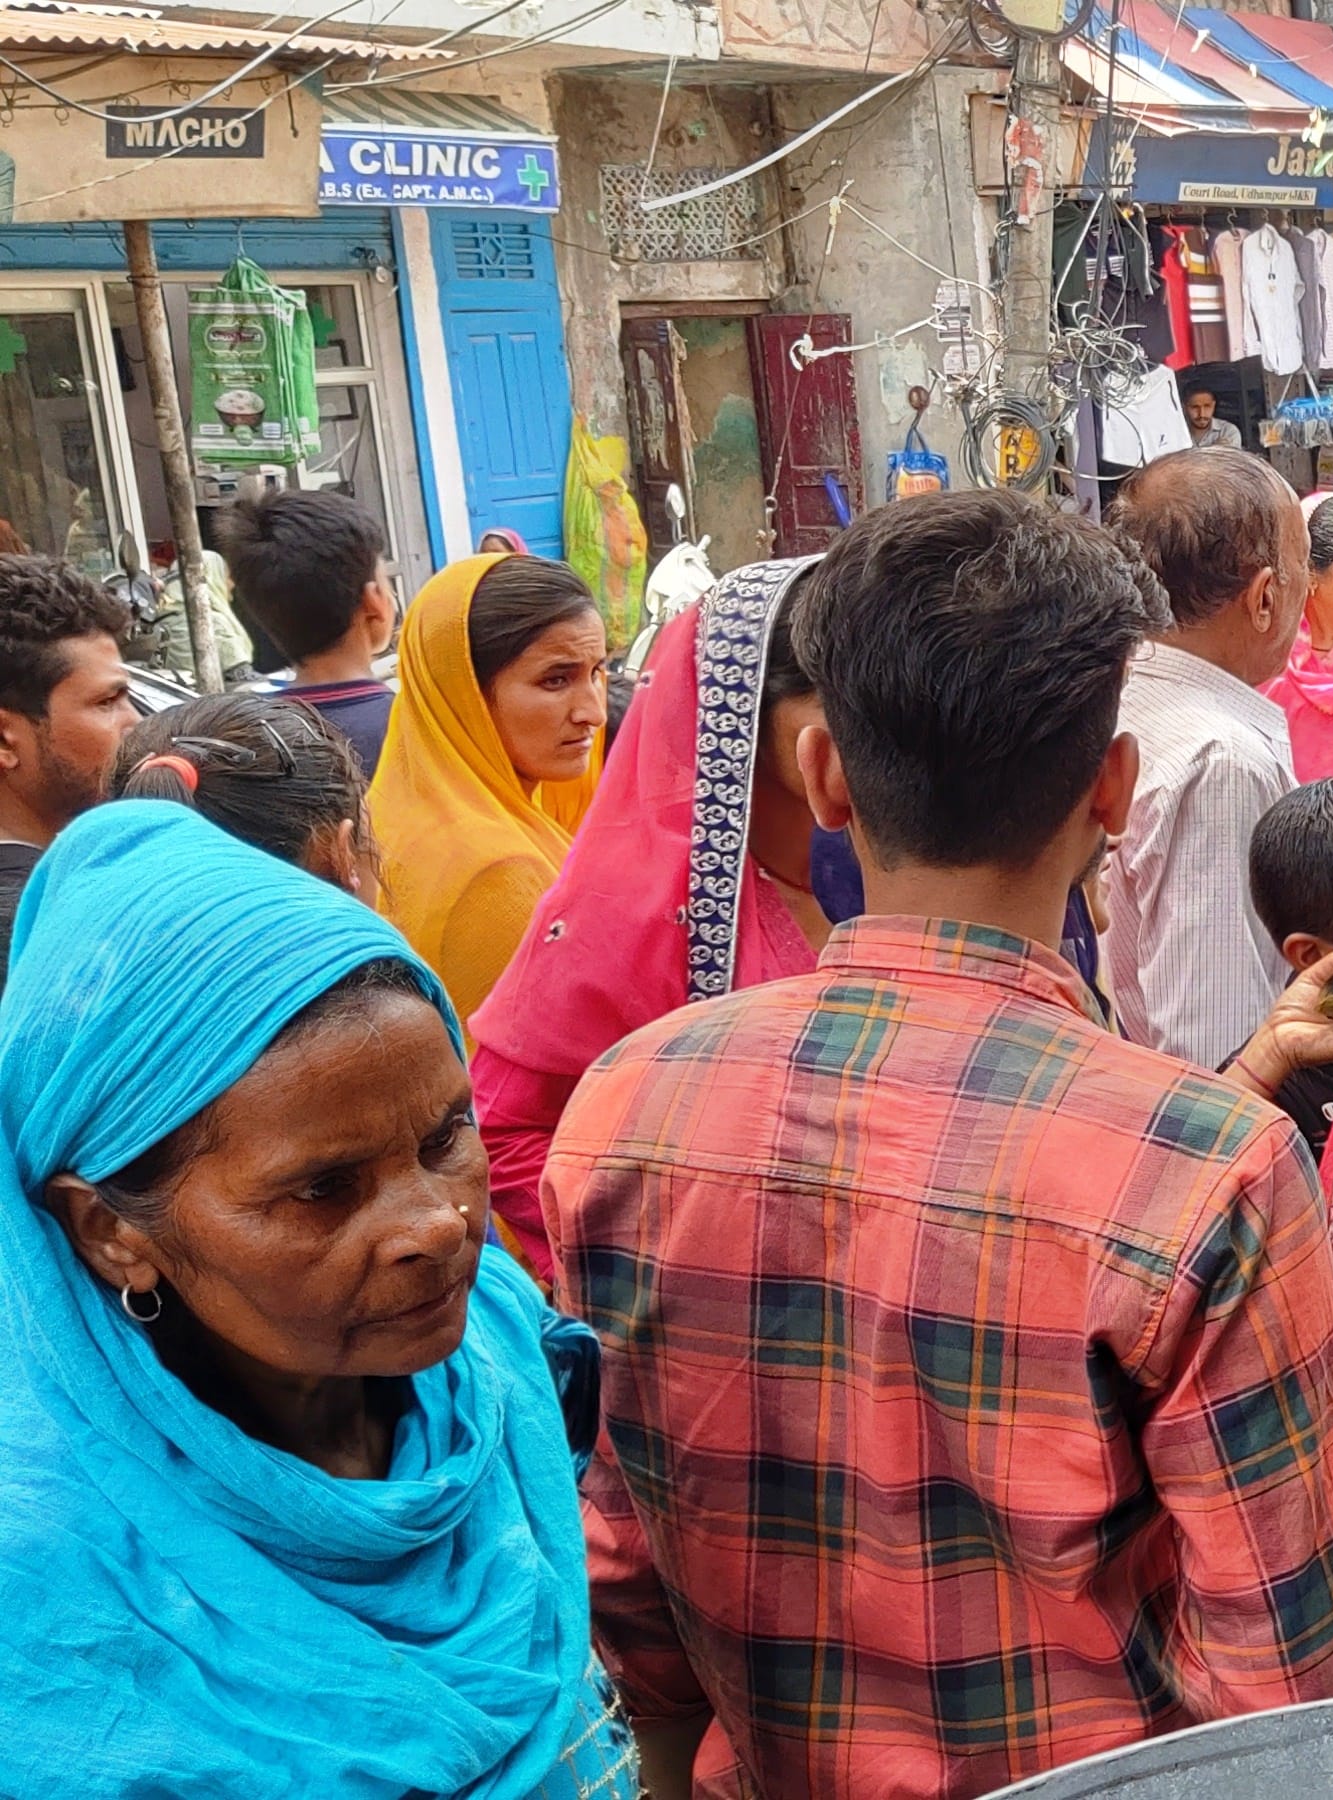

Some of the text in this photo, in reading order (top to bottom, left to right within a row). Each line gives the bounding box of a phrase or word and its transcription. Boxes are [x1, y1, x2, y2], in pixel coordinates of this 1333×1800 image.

[126, 117, 247, 149] MACHO
[349, 140, 501, 179] CLINIC
[1183, 186, 1211, 198] Court
